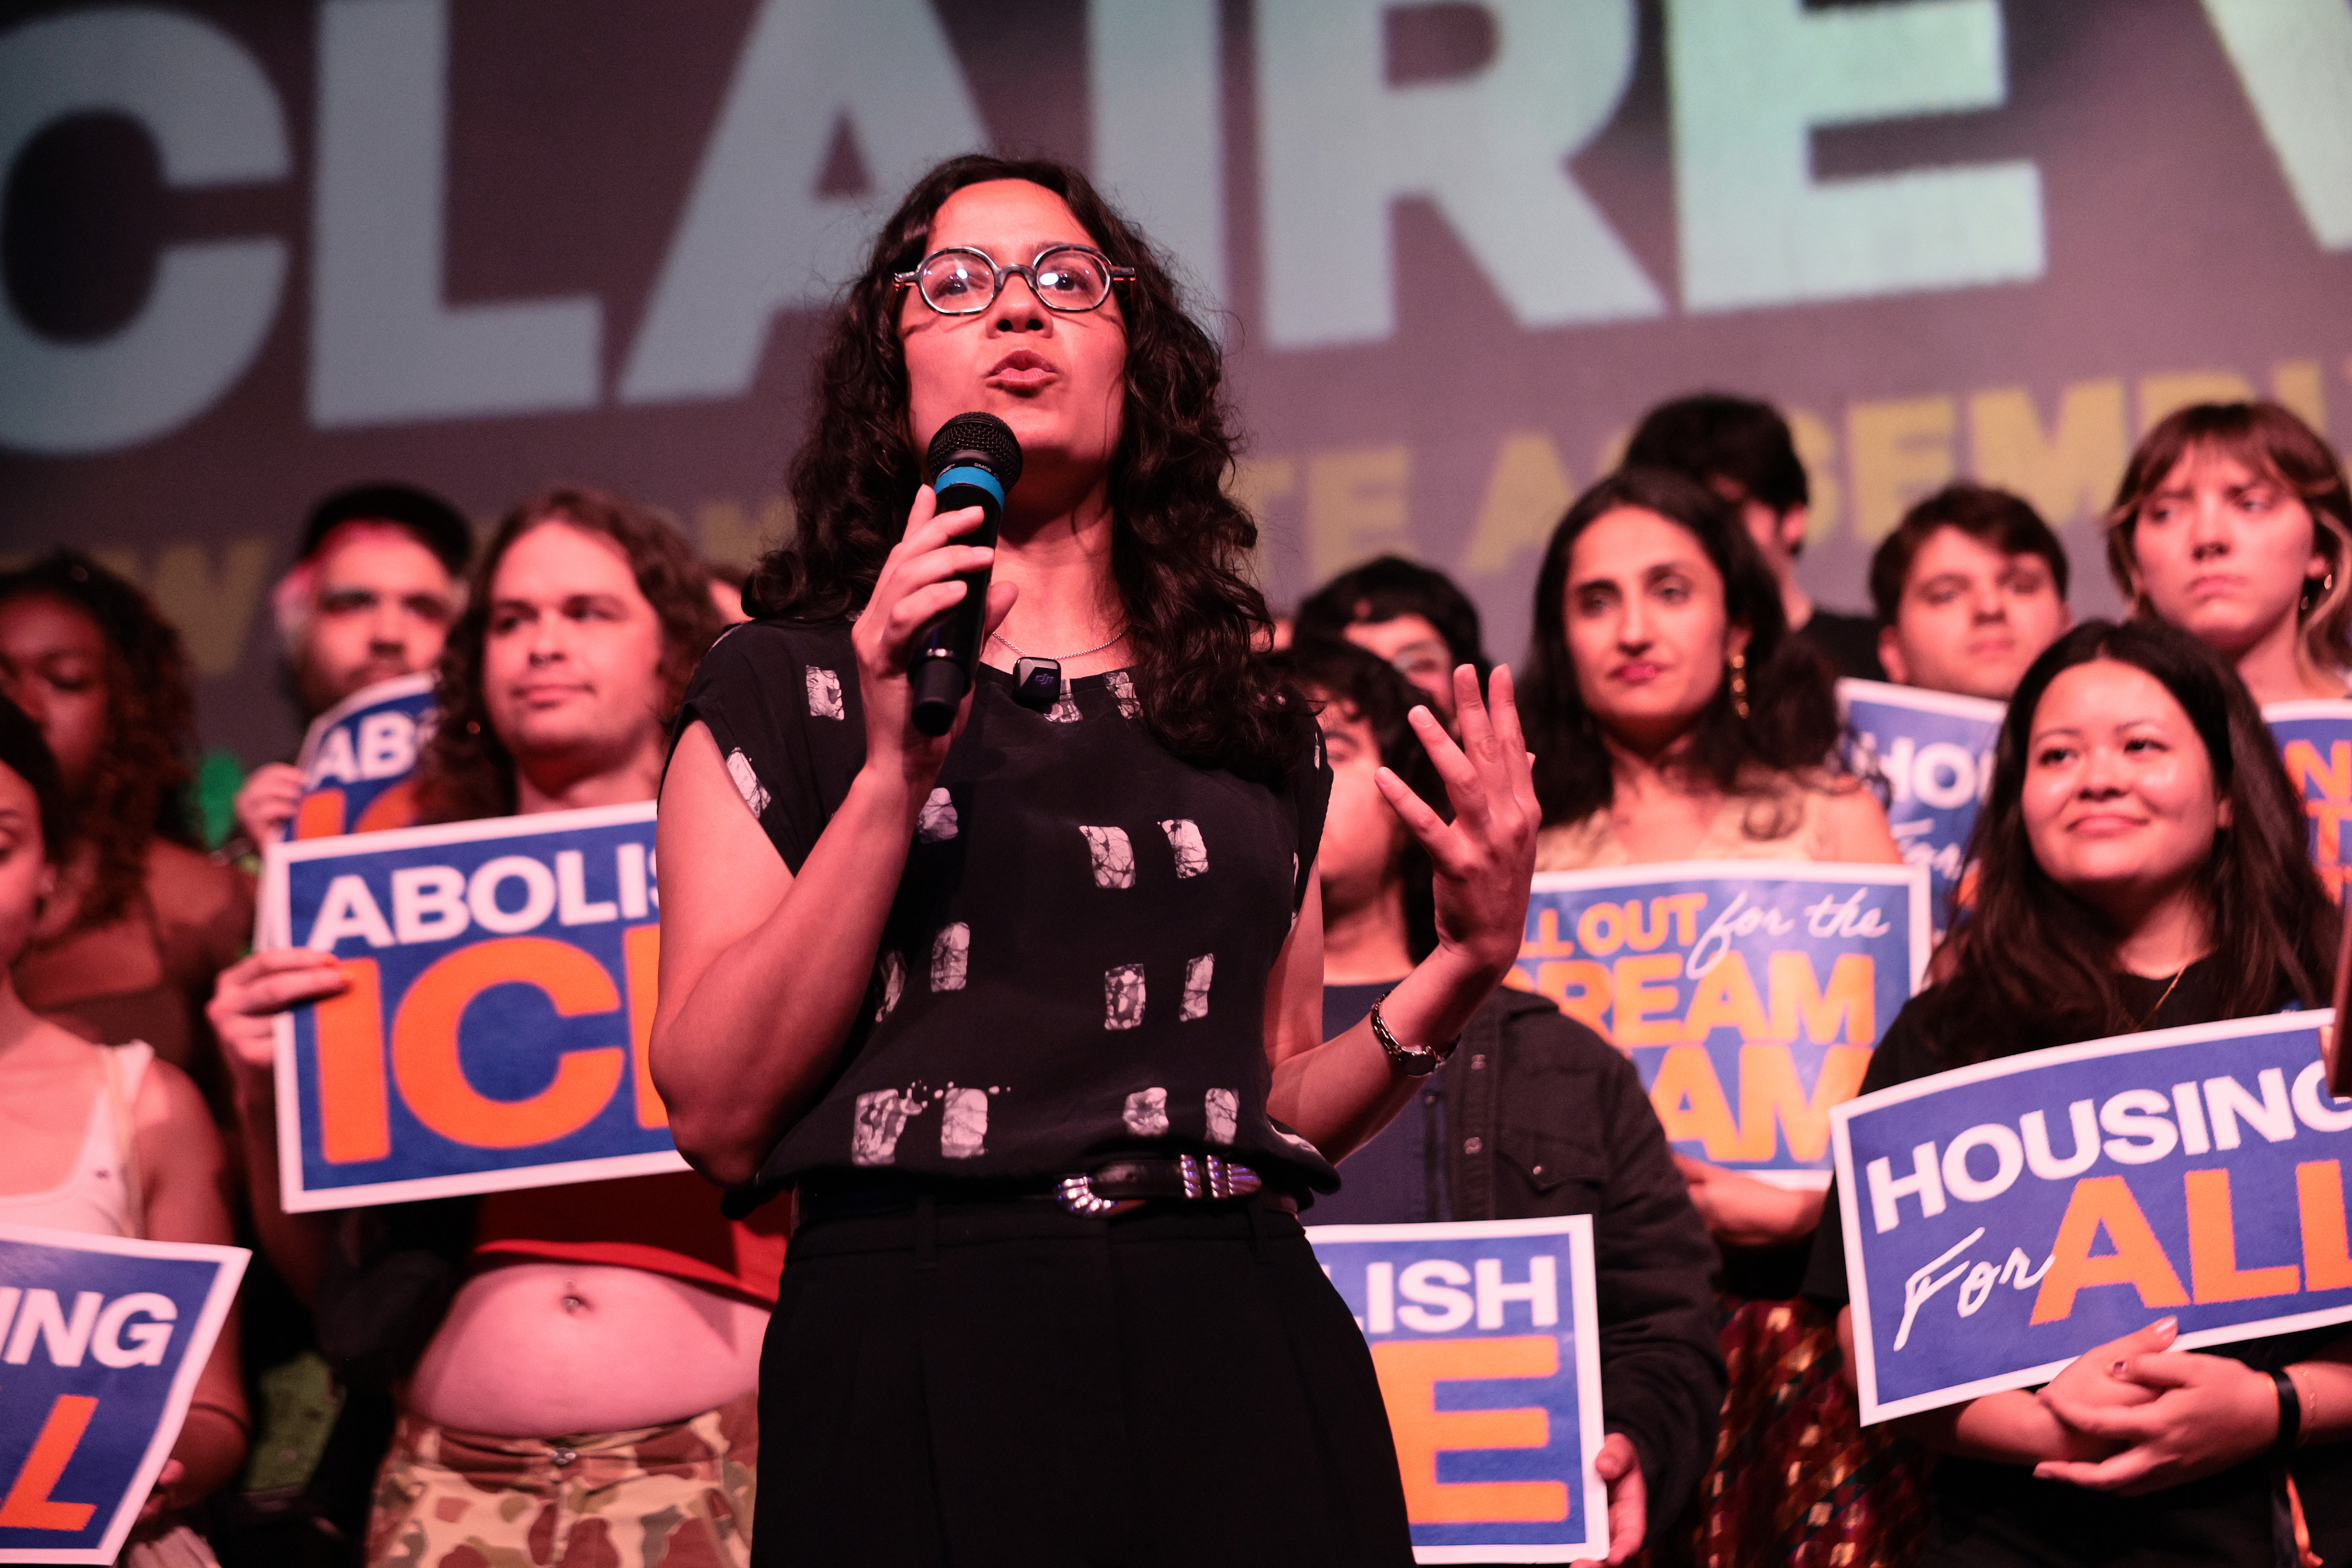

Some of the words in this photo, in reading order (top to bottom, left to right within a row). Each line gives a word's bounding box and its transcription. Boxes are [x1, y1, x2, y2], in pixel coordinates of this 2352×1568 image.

[306, 843, 660, 954] ABOLI
[1577, 892, 1708, 956] OUT
[1686, 888, 1796, 980] for
[1804, 886, 1891, 938] the
[1494, 949, 1876, 1050] REAM
[1893, 1226, 2056, 1352] For
[2029, 1159, 2352, 1327] ALL
